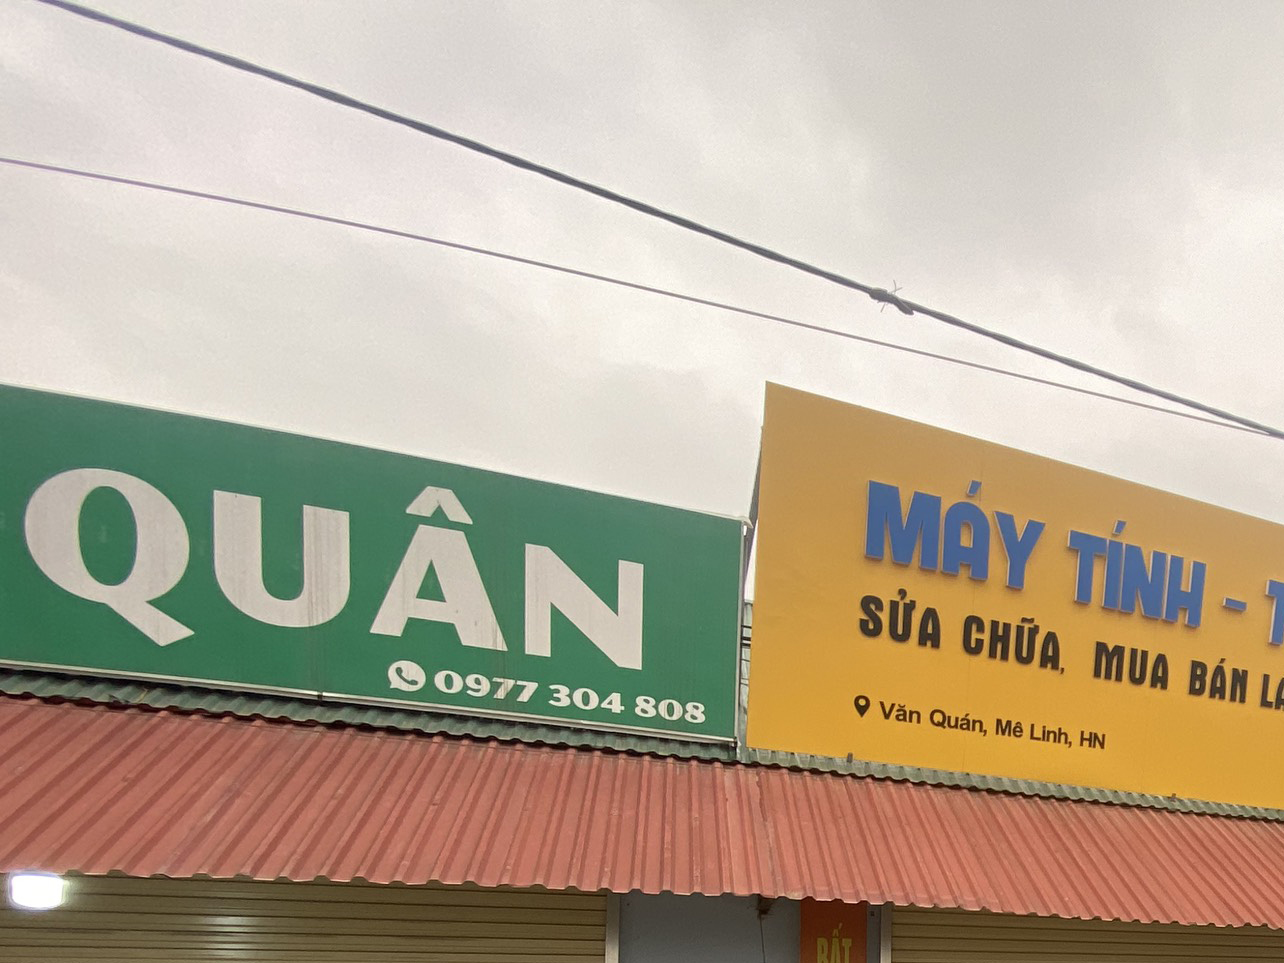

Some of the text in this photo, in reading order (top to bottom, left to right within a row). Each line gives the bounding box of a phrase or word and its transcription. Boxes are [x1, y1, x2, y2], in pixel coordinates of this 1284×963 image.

[24, 468, 645, 671] QUÂN
[865, 480, 1045, 590] MÁY
[1067, 520, 1207, 627] TÍNH
[1223, 596, 1246, 612] -
[434, 669, 706, 725] 0977 304 808
[859, 588, 941, 649] SỬA
[1094, 641, 1169, 691] MUA
[1188, 658, 1248, 704] BÁN
[879, 701, 1105, 749] Văn Quán, Mê Linh, HN
